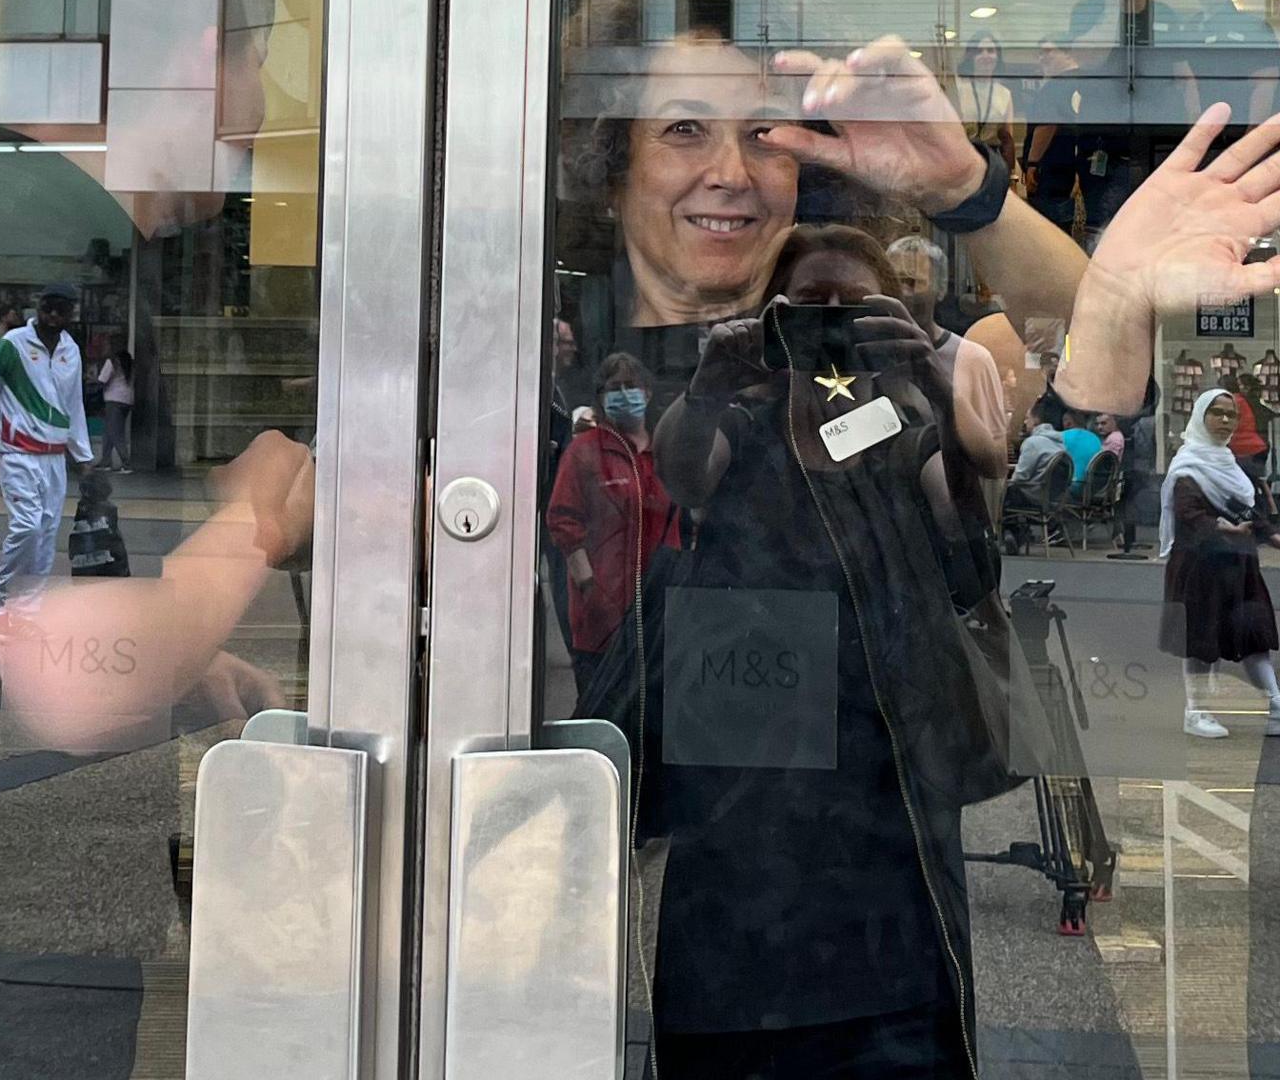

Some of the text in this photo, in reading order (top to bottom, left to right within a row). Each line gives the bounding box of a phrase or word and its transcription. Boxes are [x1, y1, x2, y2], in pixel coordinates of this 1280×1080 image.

[824, 421, 849, 439] M&S
[39, 636, 137, 675] M&S
[701, 650, 800, 689] M&S
